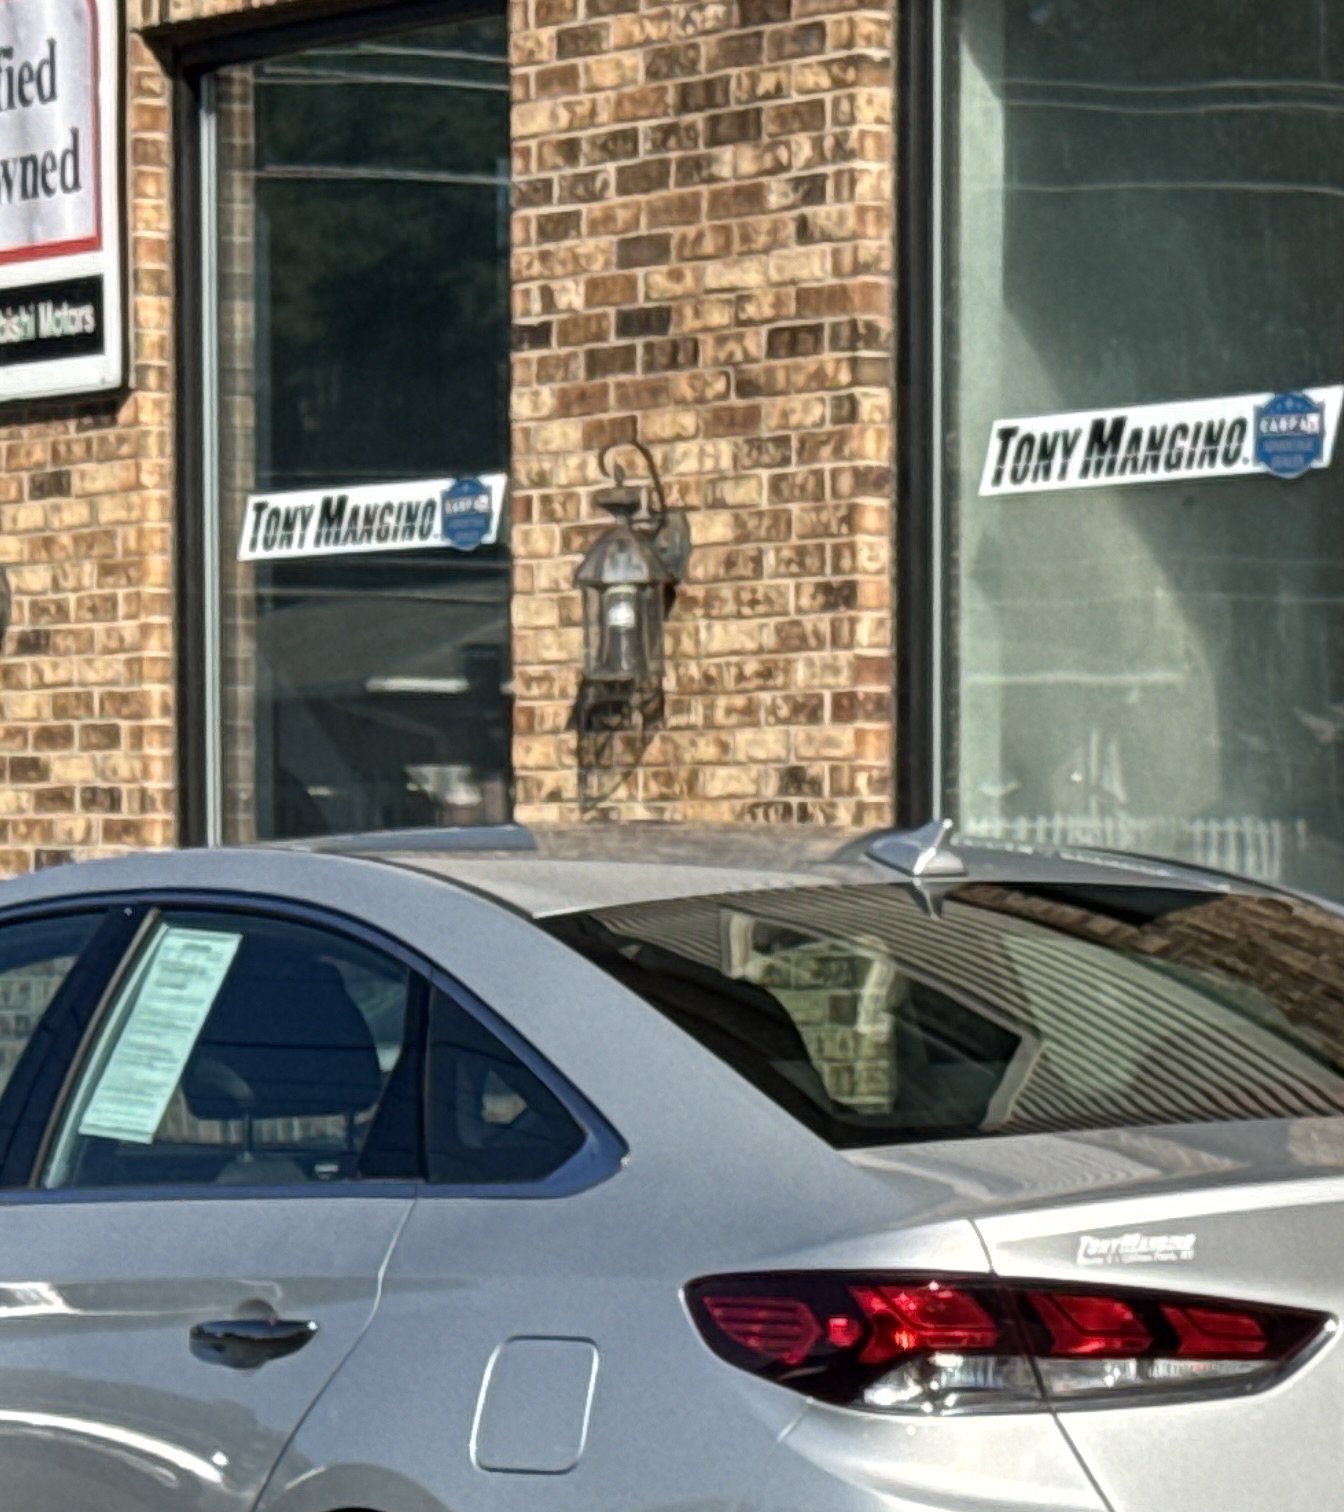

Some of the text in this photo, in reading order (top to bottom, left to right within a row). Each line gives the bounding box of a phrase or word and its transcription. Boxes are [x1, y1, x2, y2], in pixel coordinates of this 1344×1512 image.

[37, 299, 96, 339] Motors
[991, 425, 1083, 488] TONY
[248, 500, 316, 553] TONY
